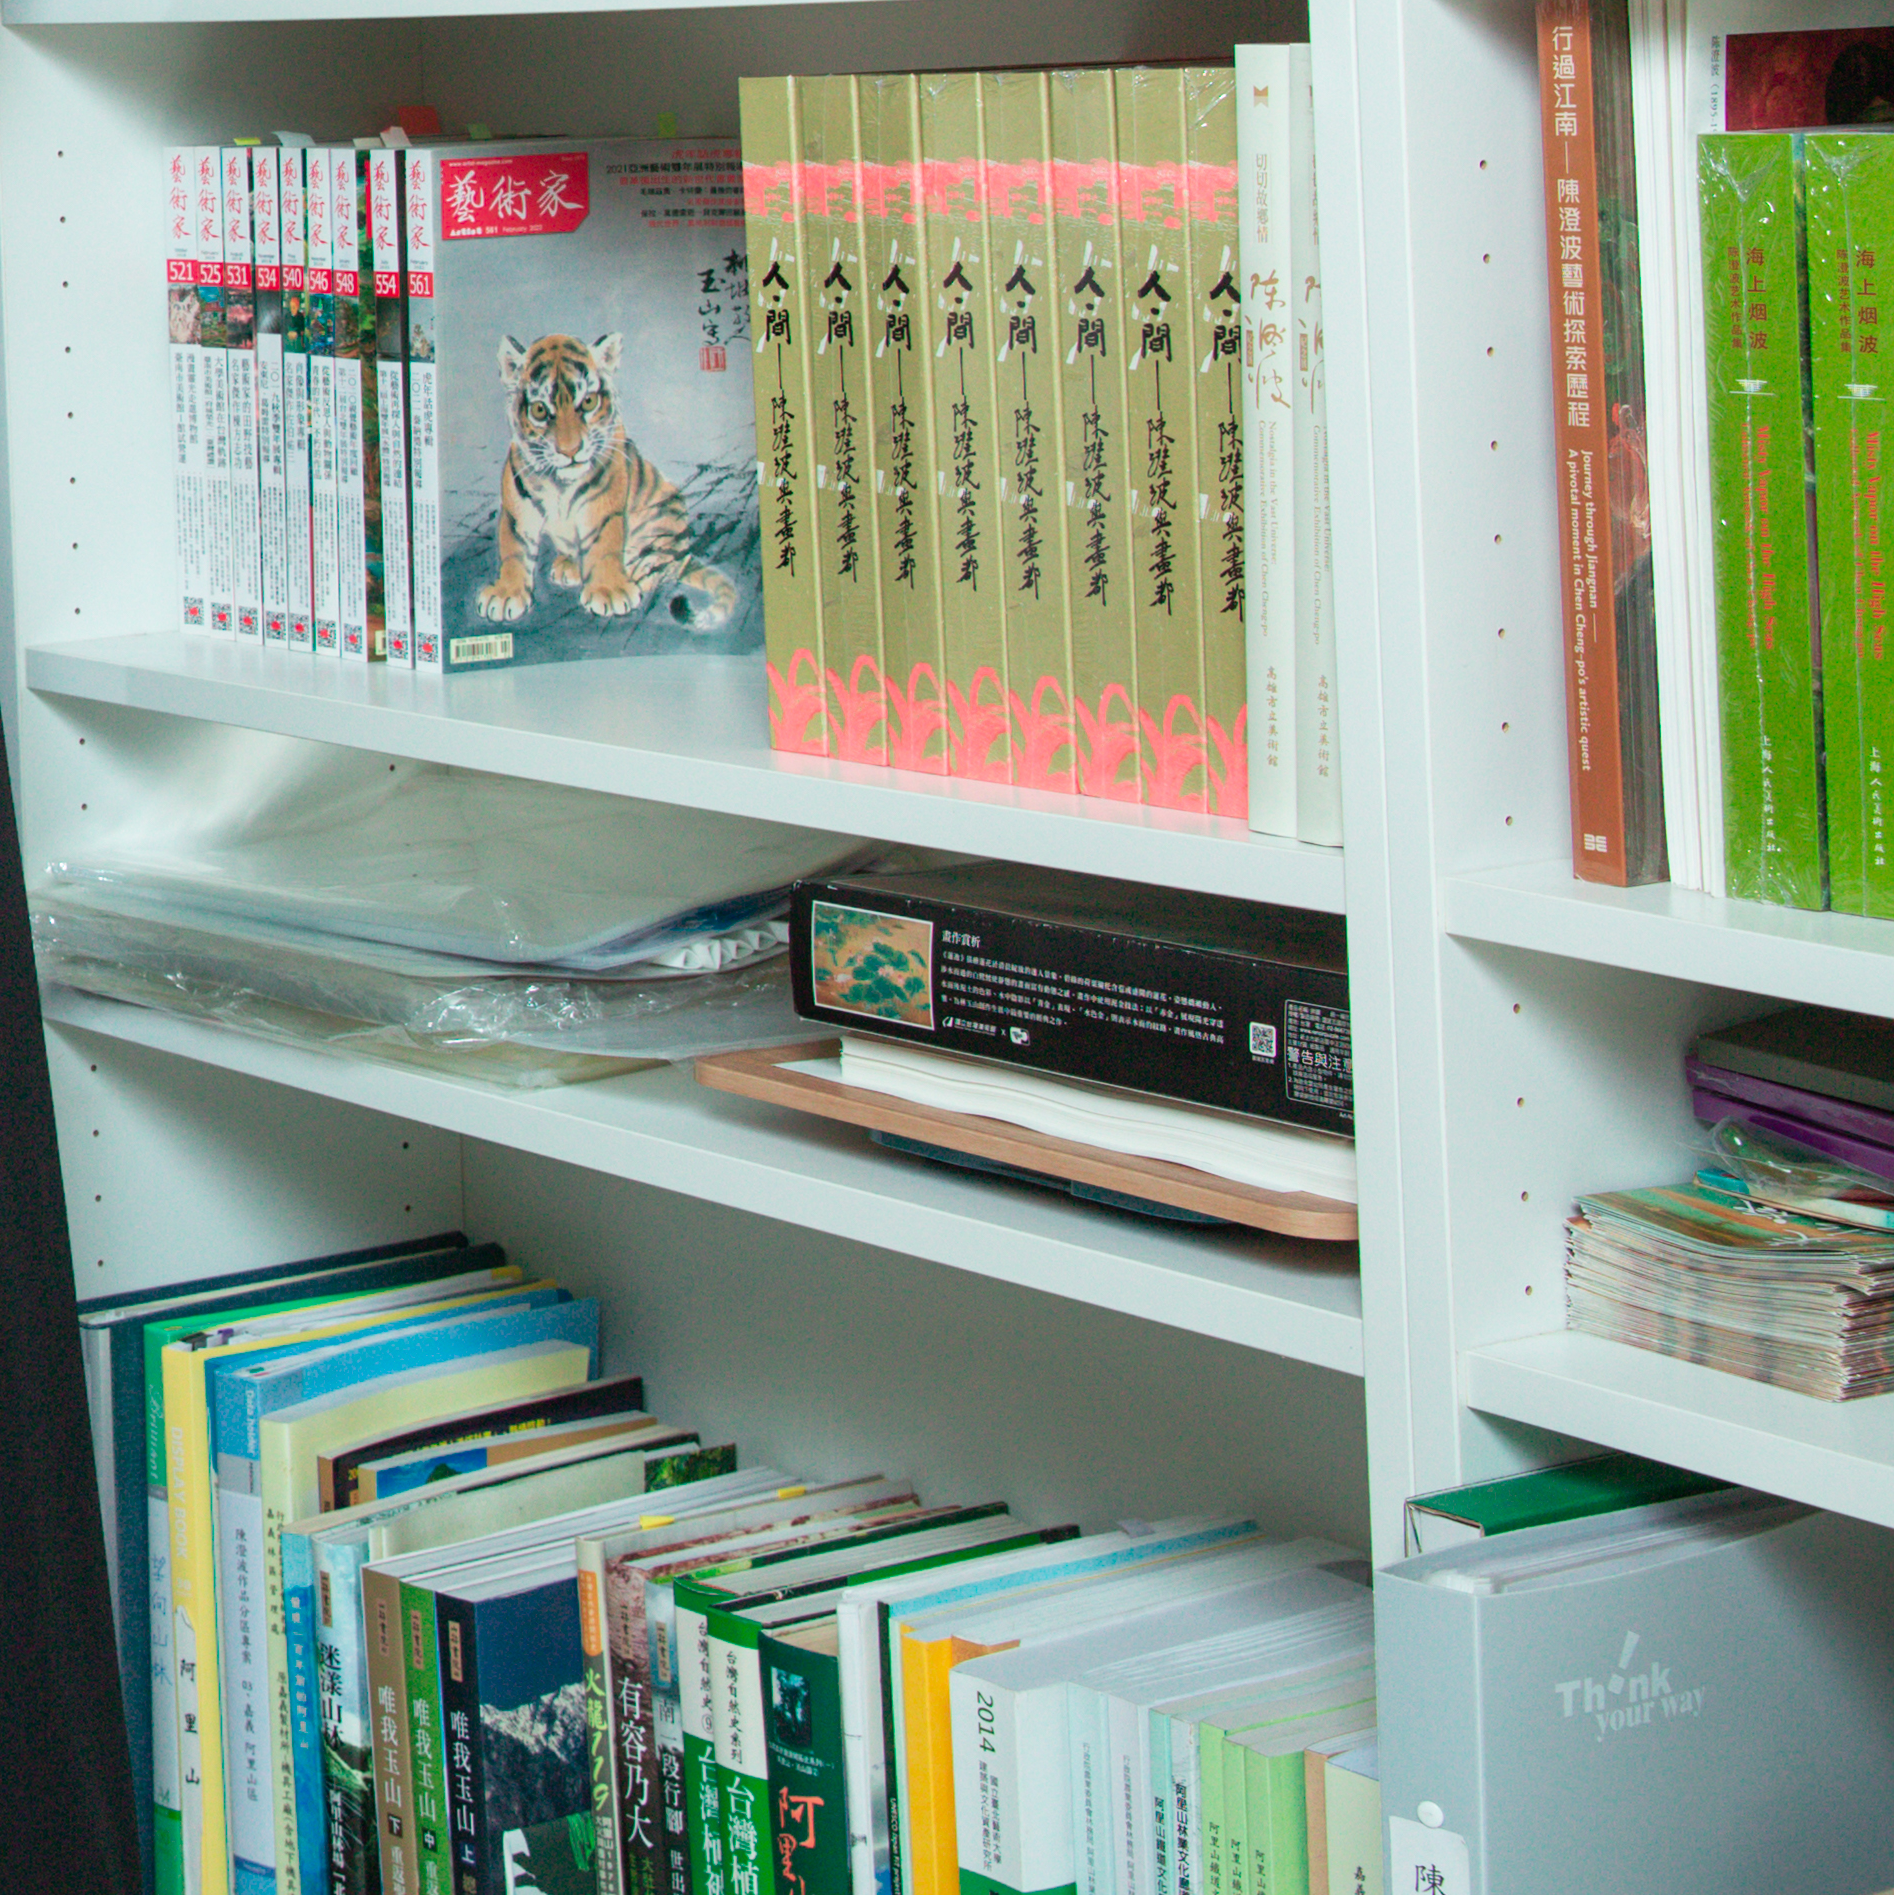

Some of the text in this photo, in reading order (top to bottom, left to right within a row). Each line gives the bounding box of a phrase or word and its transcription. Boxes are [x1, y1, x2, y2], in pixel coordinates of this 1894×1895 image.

[169, 154, 192, 240] 藝術家
[198, 156, 221, 242] 藝術家
[225, 157, 247, 243] 藝術家
[256, 158, 277, 245] 藝術家
[282, 157, 302, 244] 藝術家
[308, 160, 328, 248] 藝術家
[334, 161, 355, 249] 藝術家
[445, 168, 586, 224] 藝術家
[1549, 24, 1592, 429] 行過江南 陳澄波藝術探索歷程
[169, 261, 195, 281] 521
[199, 263, 222, 284] 525
[226, 265, 249, 286] 531
[257, 267, 277, 287] 534
[282, 268, 303, 289] 540
[308, 271, 329, 292] 546
[336, 273, 355, 294] 548
[375, 274, 397, 295] 554
[409, 275, 431, 295] 561
[1745, 245, 1769, 351] 海上烟波
[1855, 247, 1880, 357] 海上烟波
[1258, 420, 1268, 498] Commemorative
[1268, 420, 1279, 466] Nostalgia
[1312, 424, 1322, 504] Commemorative
[1259, 499, 1269, 550] Exhibition
[1269, 497, 1279, 520] Vast
[1312, 506, 1322, 557] Exhibition
[1581, 450, 1600, 609] Journey through Jiangnan
[1755, 425, 1777, 650] Misty Vapor on the High Seas
[1864, 430, 1887, 660] Misty Vapor on the High Seas
[1259, 590, 1270, 638] Cheng-po
[1312, 597, 1323, 646] Cheng-po
[1567, 448, 1592, 772] A pivotal moment in Chen Cheng-po's artistic quest
[244, 1388, 257, 1455] Data holder
[170, 1426, 189, 1561] DISPLAY BOOK
[178, 1657, 201, 1787] 阿里山
[584, 1666, 610, 1812] 火龍119
[976, 1690, 997, 1754] 2014
[1593, 1681, 1707, 1744] your way
[377, 1684, 403, 1836] 唯我玉山 下
[412, 1697, 437, 1851] 唯我玉山 中
[450, 1709, 476, 1865] 唯我玉山 上
[617, 1676, 655, 1850] 有容乃大
